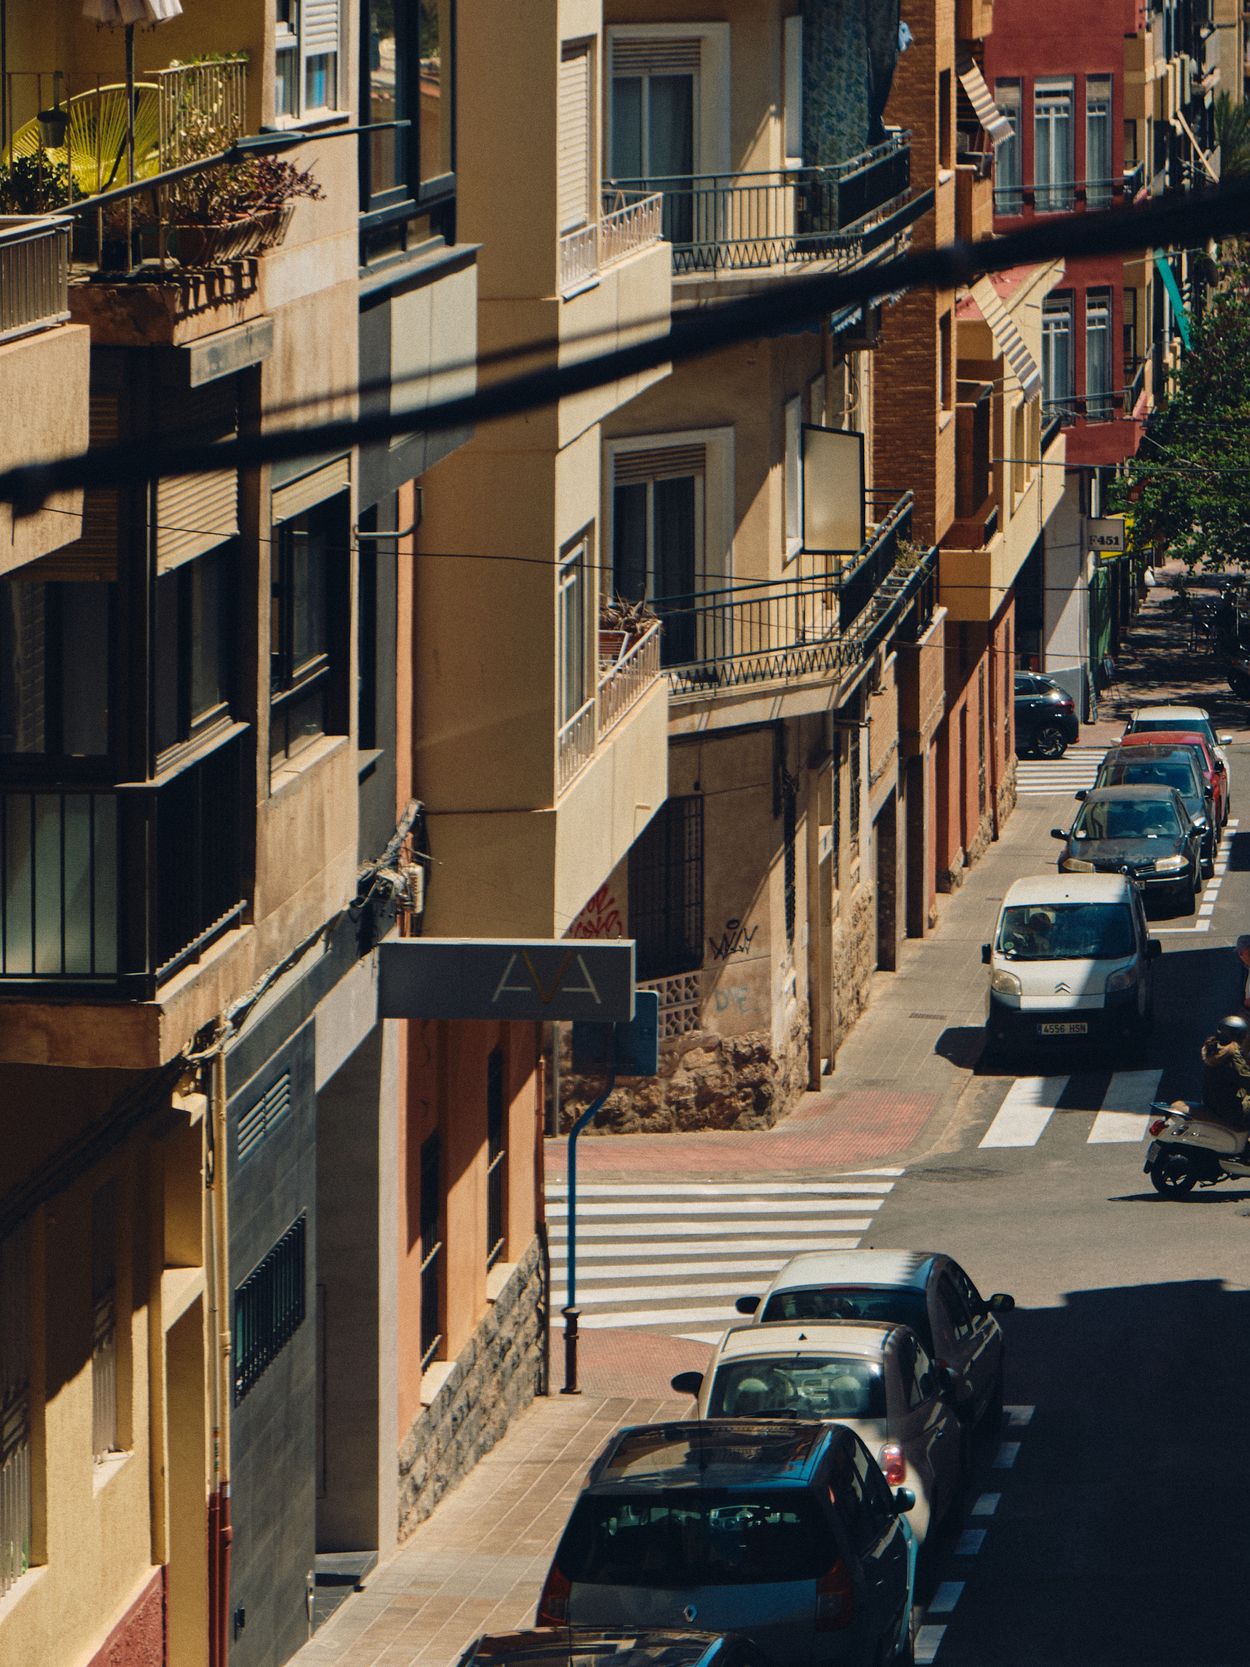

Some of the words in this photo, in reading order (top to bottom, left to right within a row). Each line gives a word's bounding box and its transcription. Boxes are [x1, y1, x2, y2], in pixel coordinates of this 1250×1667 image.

[1088, 535, 1120, 546] F451
[491, 949, 602, 1005] AVA
[1043, 1024, 1066, 1034] 4556
